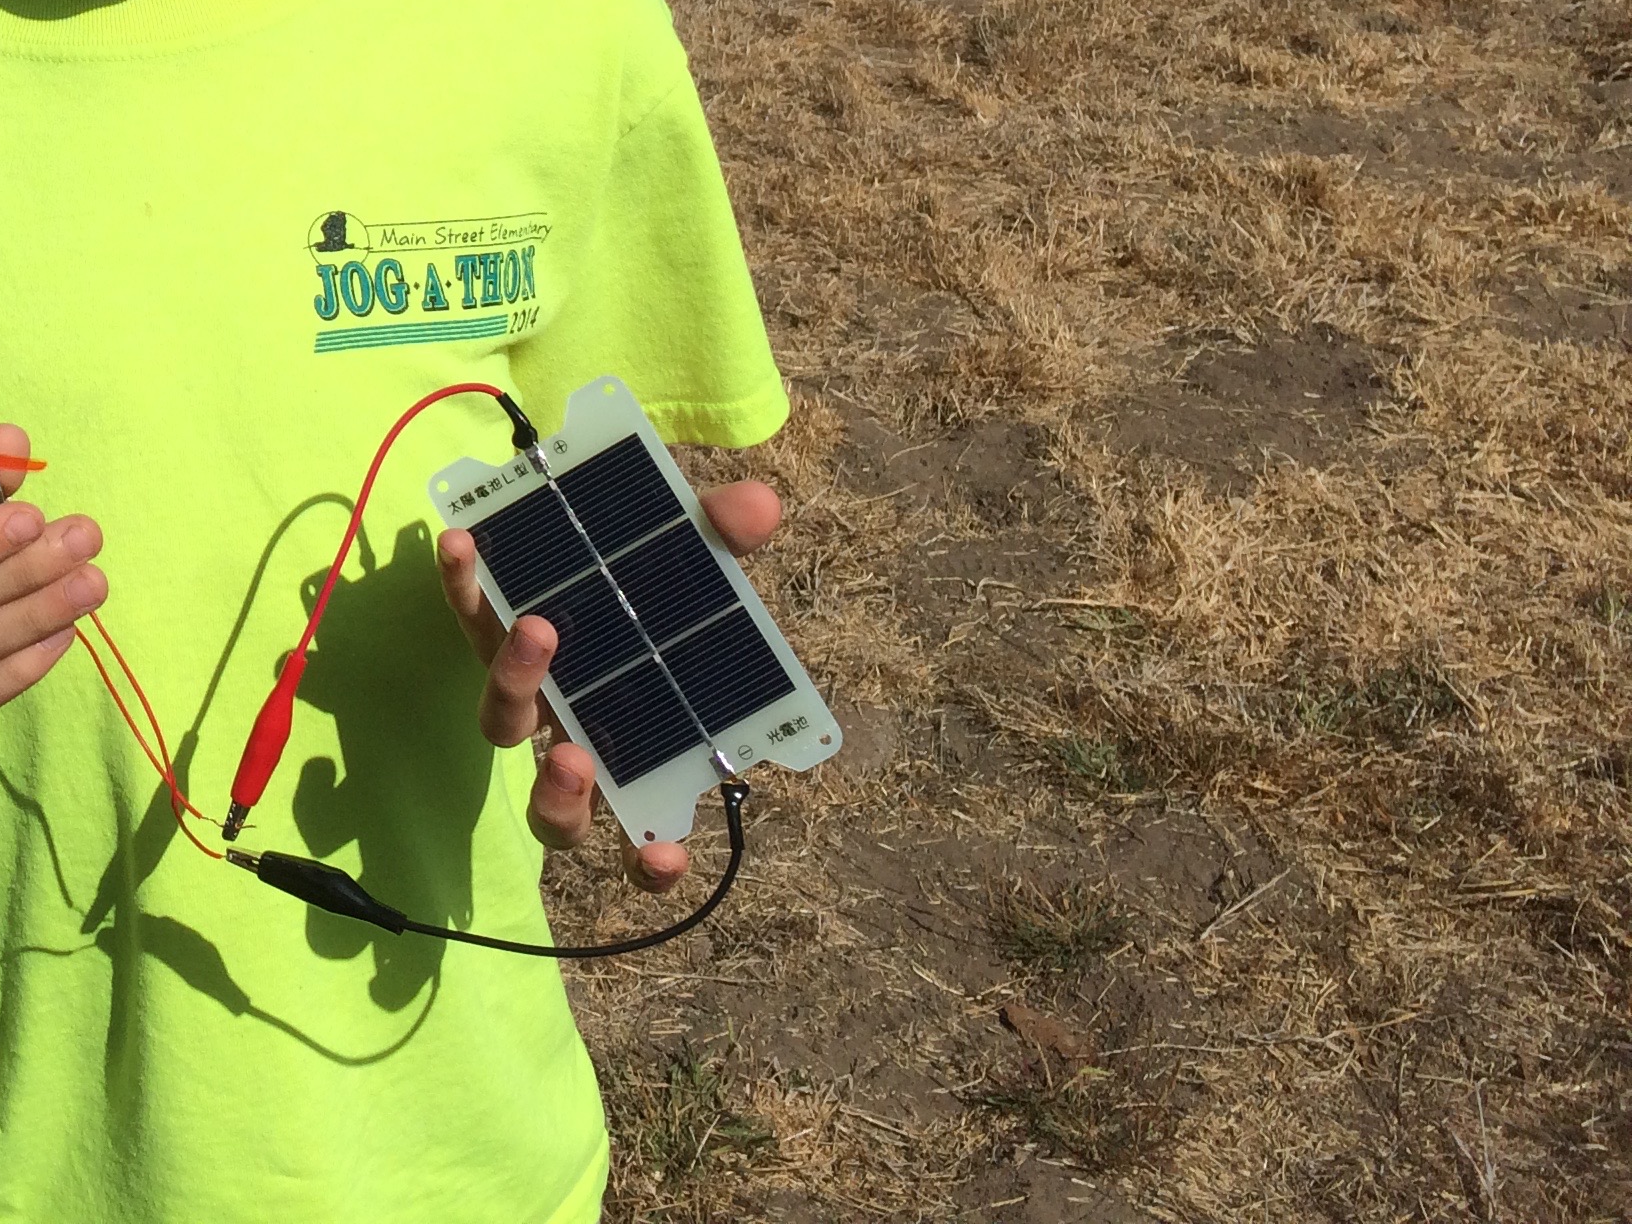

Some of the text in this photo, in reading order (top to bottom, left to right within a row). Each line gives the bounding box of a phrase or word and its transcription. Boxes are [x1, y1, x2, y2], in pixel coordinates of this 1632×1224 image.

[380, 220, 553, 247] Main Street Elementary
[509, 305, 540, 334] 2014
